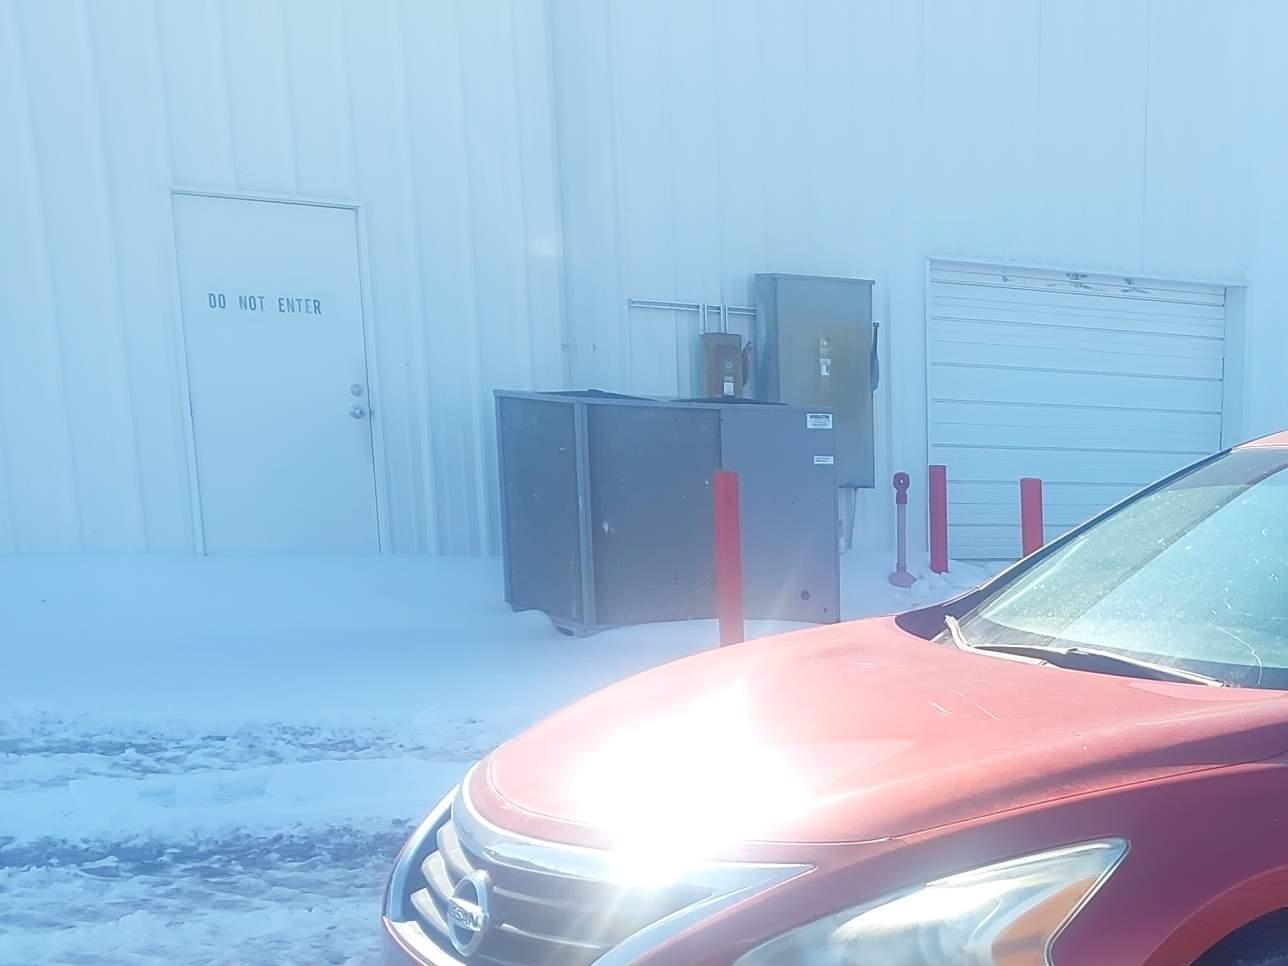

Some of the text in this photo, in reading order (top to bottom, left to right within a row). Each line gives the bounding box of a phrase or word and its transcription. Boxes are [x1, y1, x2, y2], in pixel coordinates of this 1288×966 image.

[207, 293, 322, 315] DO NOT ENTER
